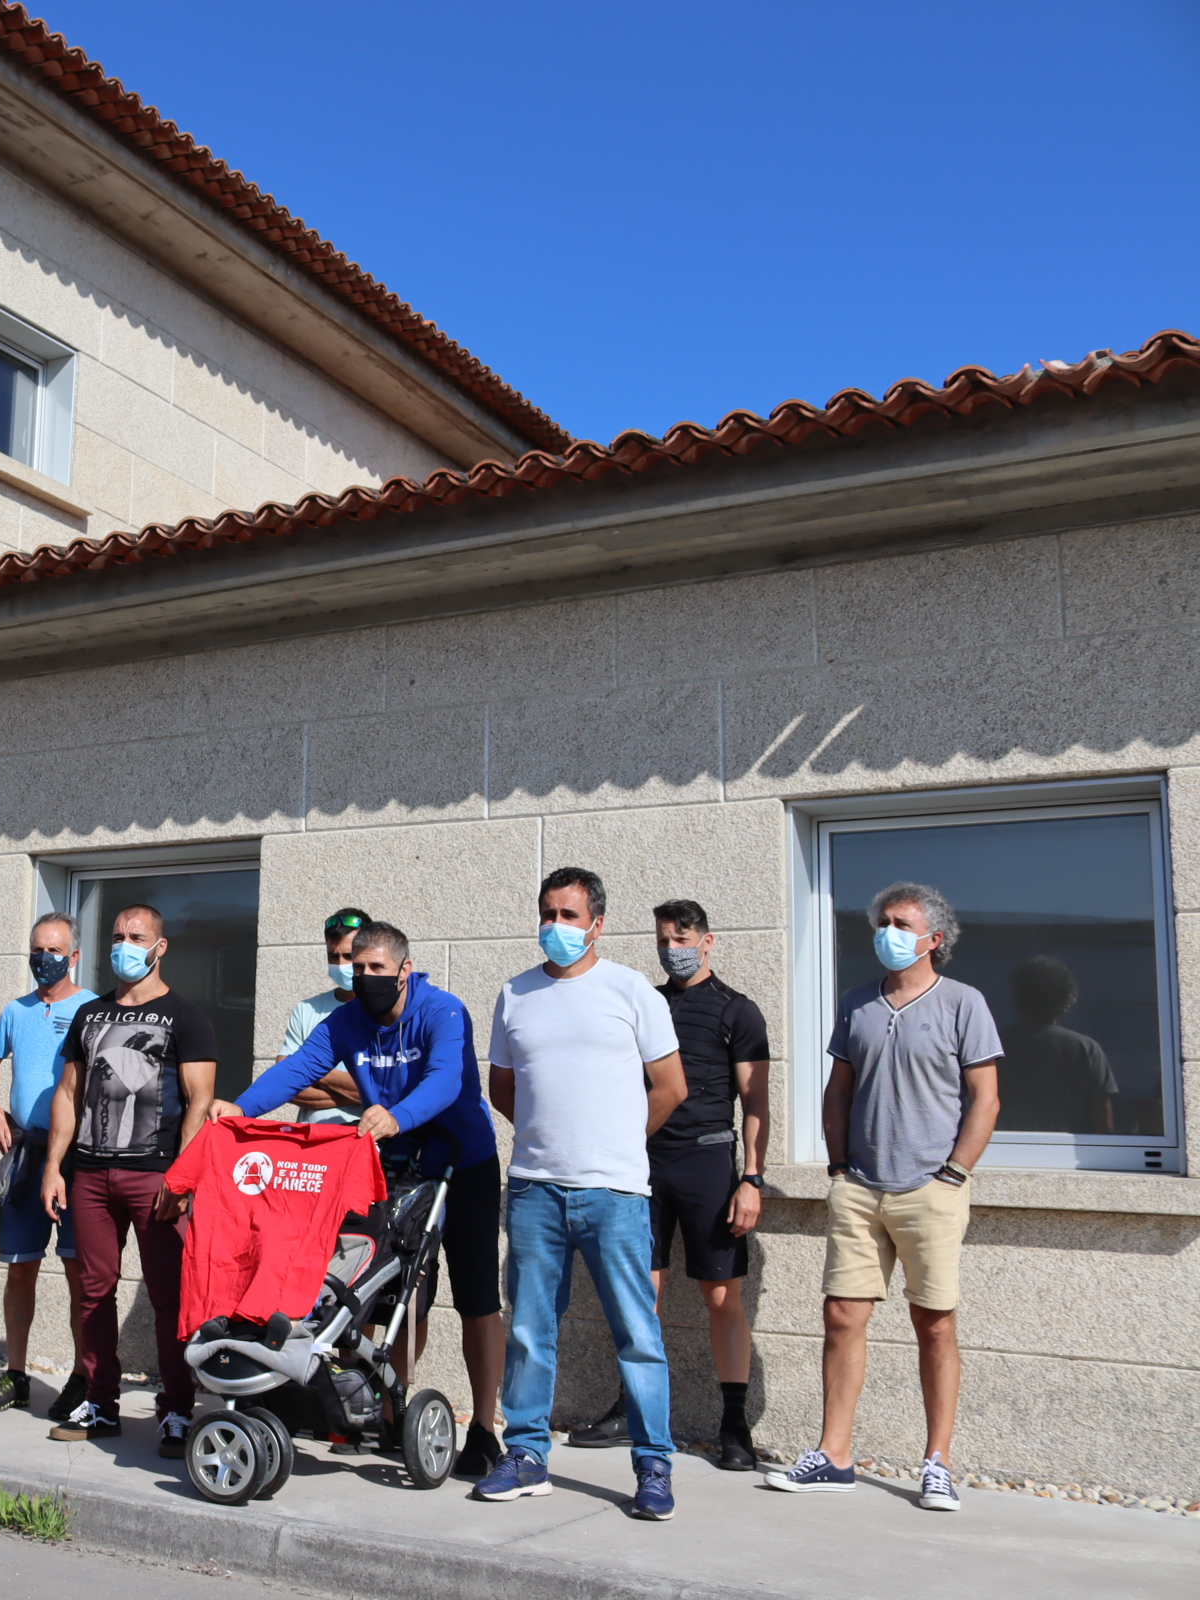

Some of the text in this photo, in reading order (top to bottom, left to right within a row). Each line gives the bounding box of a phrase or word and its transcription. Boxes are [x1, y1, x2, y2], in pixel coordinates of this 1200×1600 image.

[86, 1012, 173, 1026] RELIGION
[276, 1160, 328, 1173] NON TODO
[299, 1171, 324, 1181] QUE
[273, 1176, 324, 1193] PARECE
